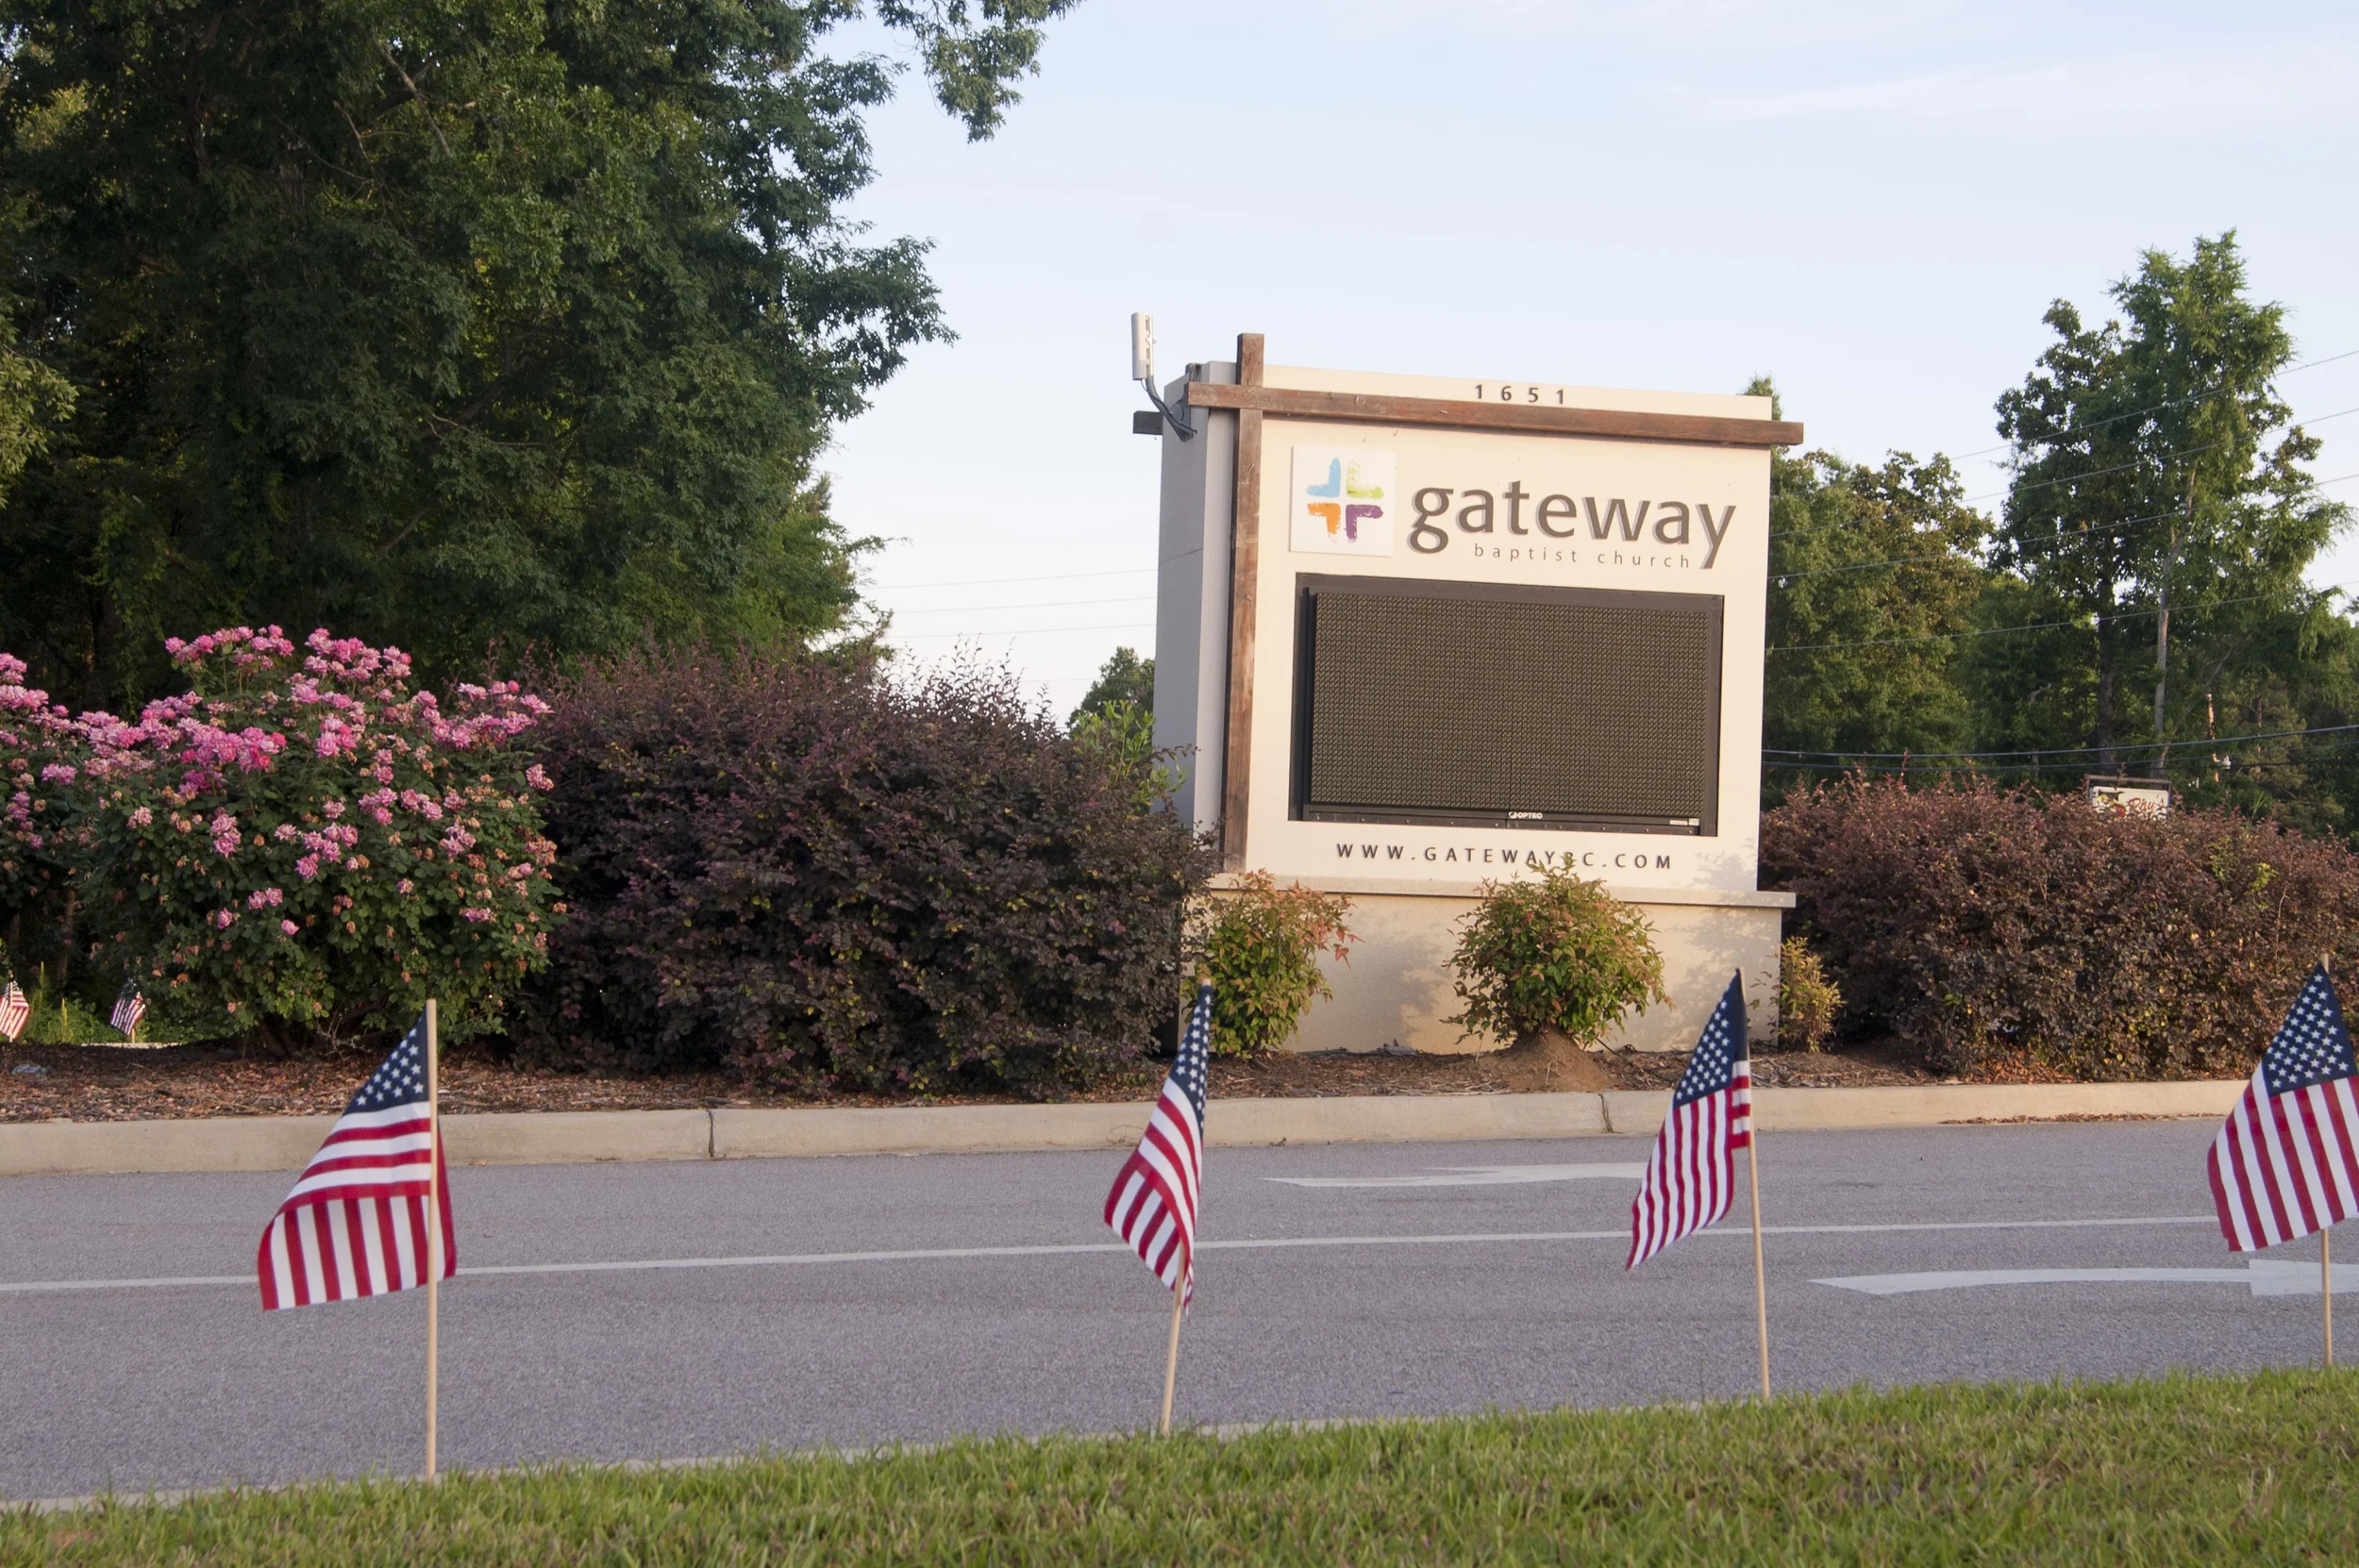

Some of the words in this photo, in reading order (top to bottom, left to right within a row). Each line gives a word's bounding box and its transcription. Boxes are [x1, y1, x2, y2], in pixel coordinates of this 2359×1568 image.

[1475, 384, 1564, 405] 1651
[1407, 480, 1737, 570] gateway
[1474, 542, 1577, 563] baptist
[1598, 551, 1690, 569] church
